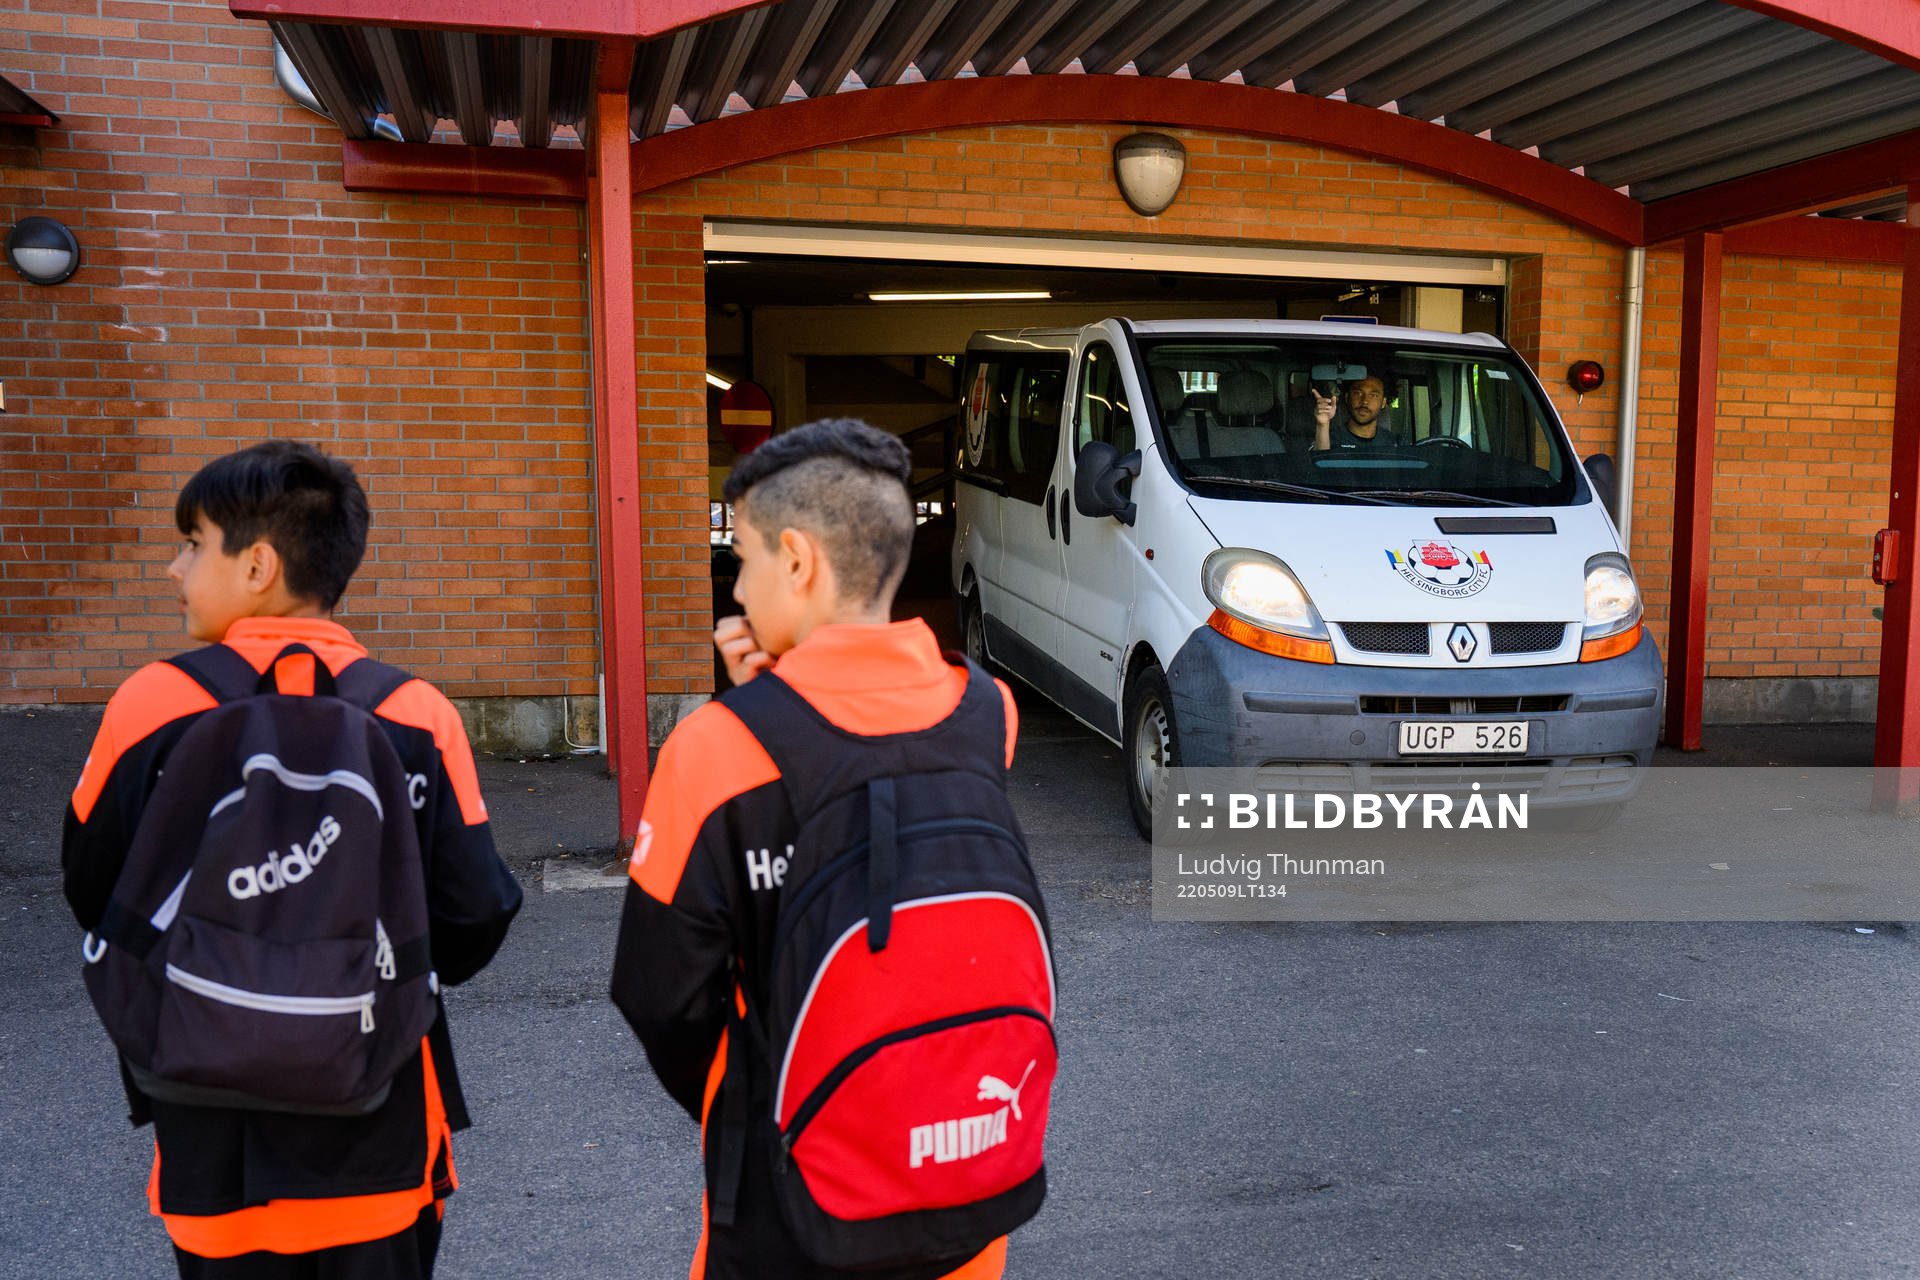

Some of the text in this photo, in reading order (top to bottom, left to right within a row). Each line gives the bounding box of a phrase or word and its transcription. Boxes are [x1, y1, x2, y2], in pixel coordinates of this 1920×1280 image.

[1400, 567, 1488, 597] HELSINGBORG CITY FC
[1406, 725, 1522, 750] UGP 526
[405, 772, 428, 810] C
[227, 815, 341, 900] adidas
[909, 1105, 1010, 1168] PUMA
